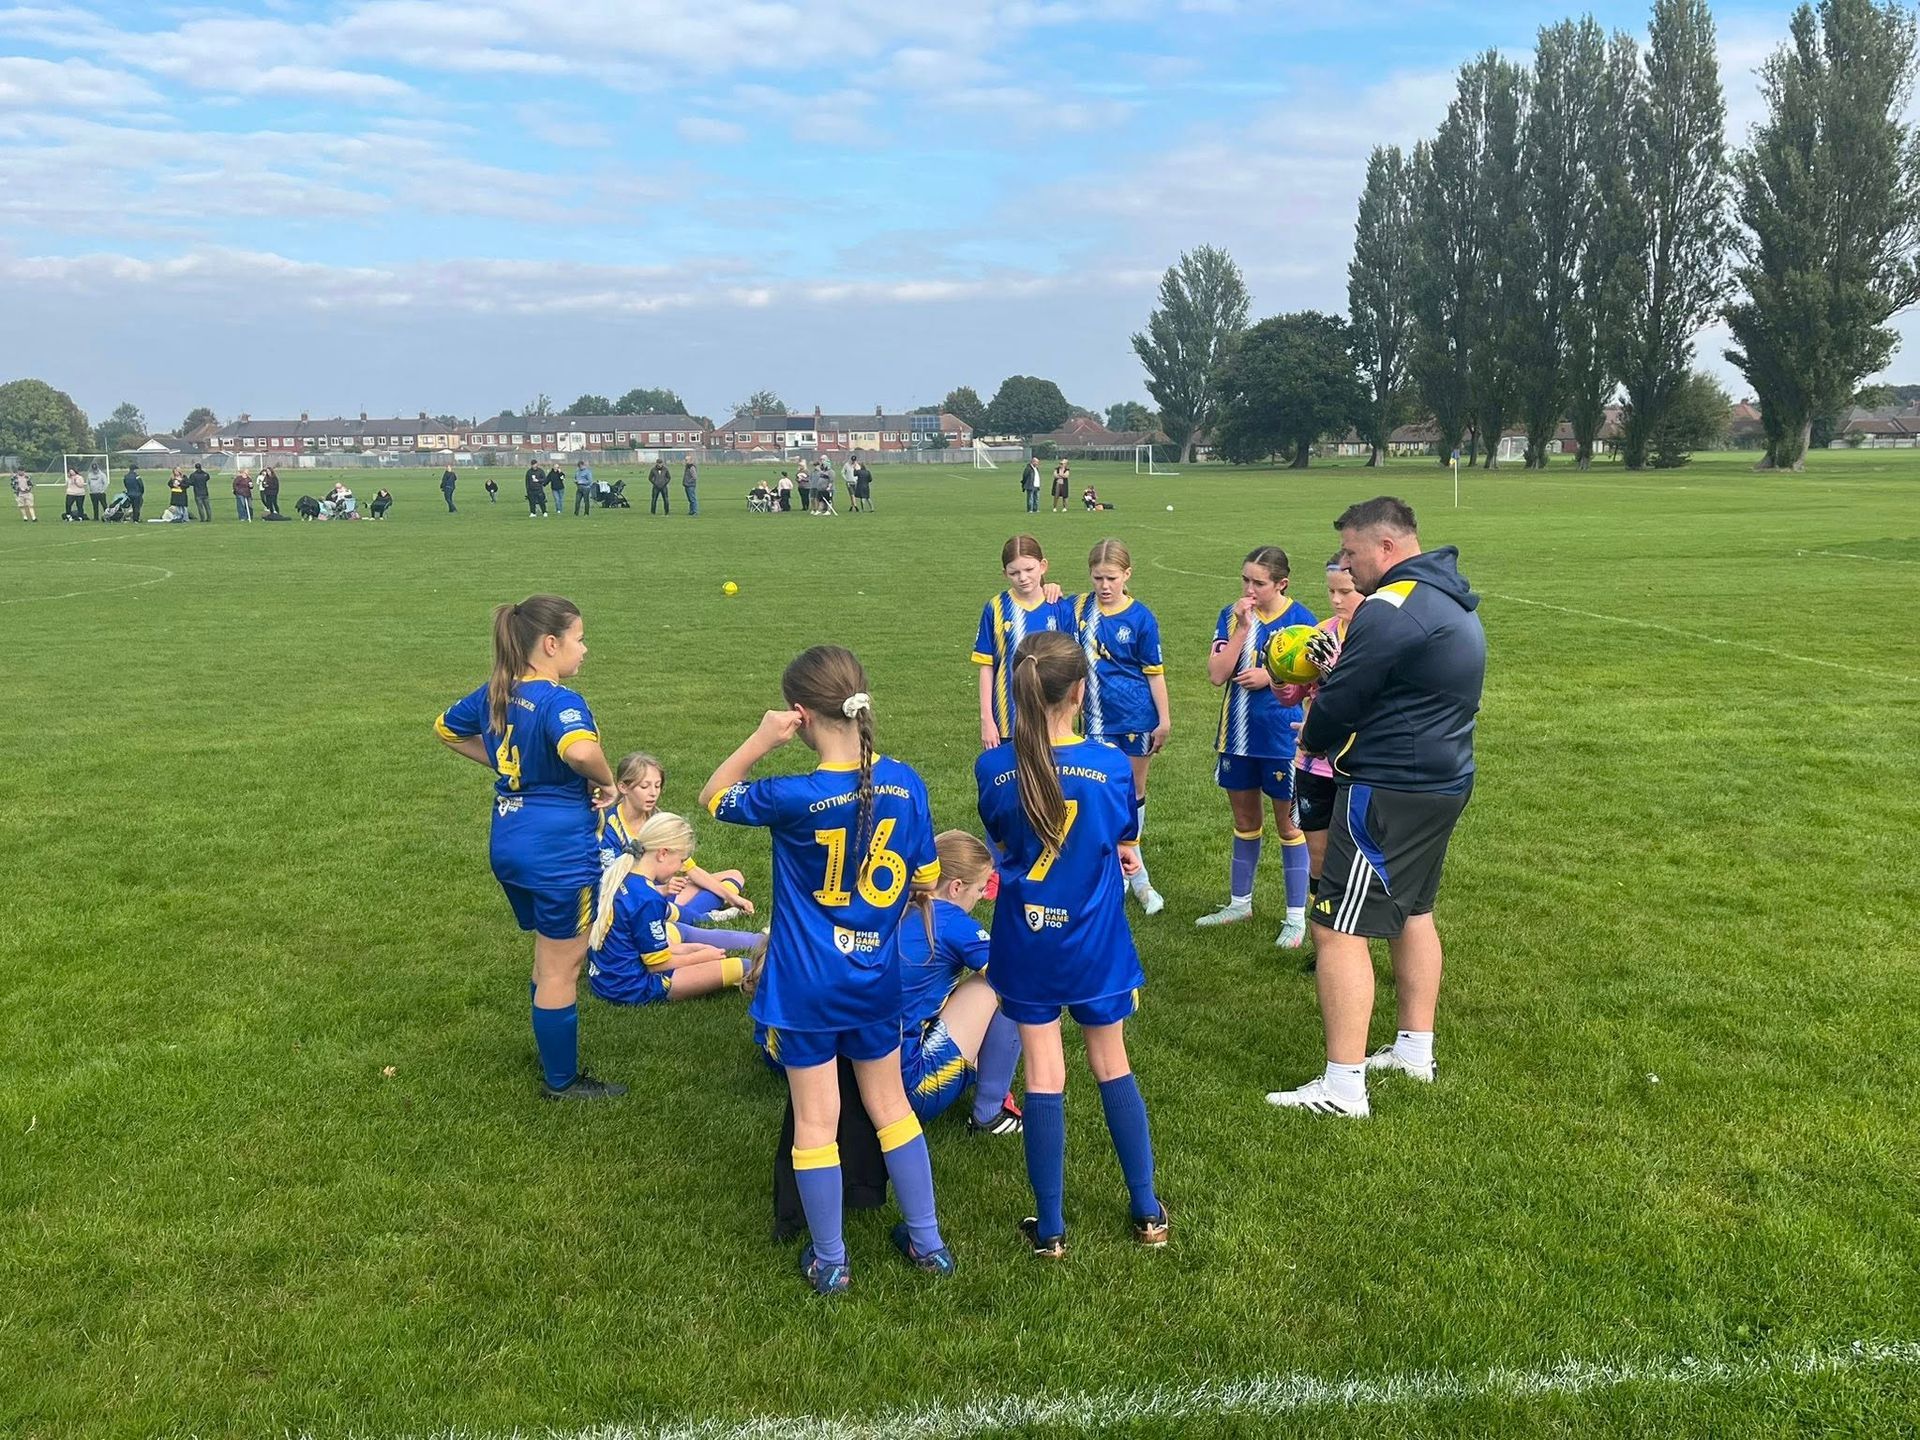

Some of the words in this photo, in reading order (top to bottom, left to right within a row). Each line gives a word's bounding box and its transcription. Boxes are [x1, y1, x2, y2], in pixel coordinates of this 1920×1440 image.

[496, 724, 521, 791] 4
[1063, 766, 1107, 784] RANGERS
[874, 785, 910, 799] RANGERS
[1026, 800, 1078, 881] 7
[812, 818, 907, 908] 16
[1045, 920, 1062, 928] TOO
[855, 937, 881, 946] GAME
[855, 944, 873, 953] TOO
